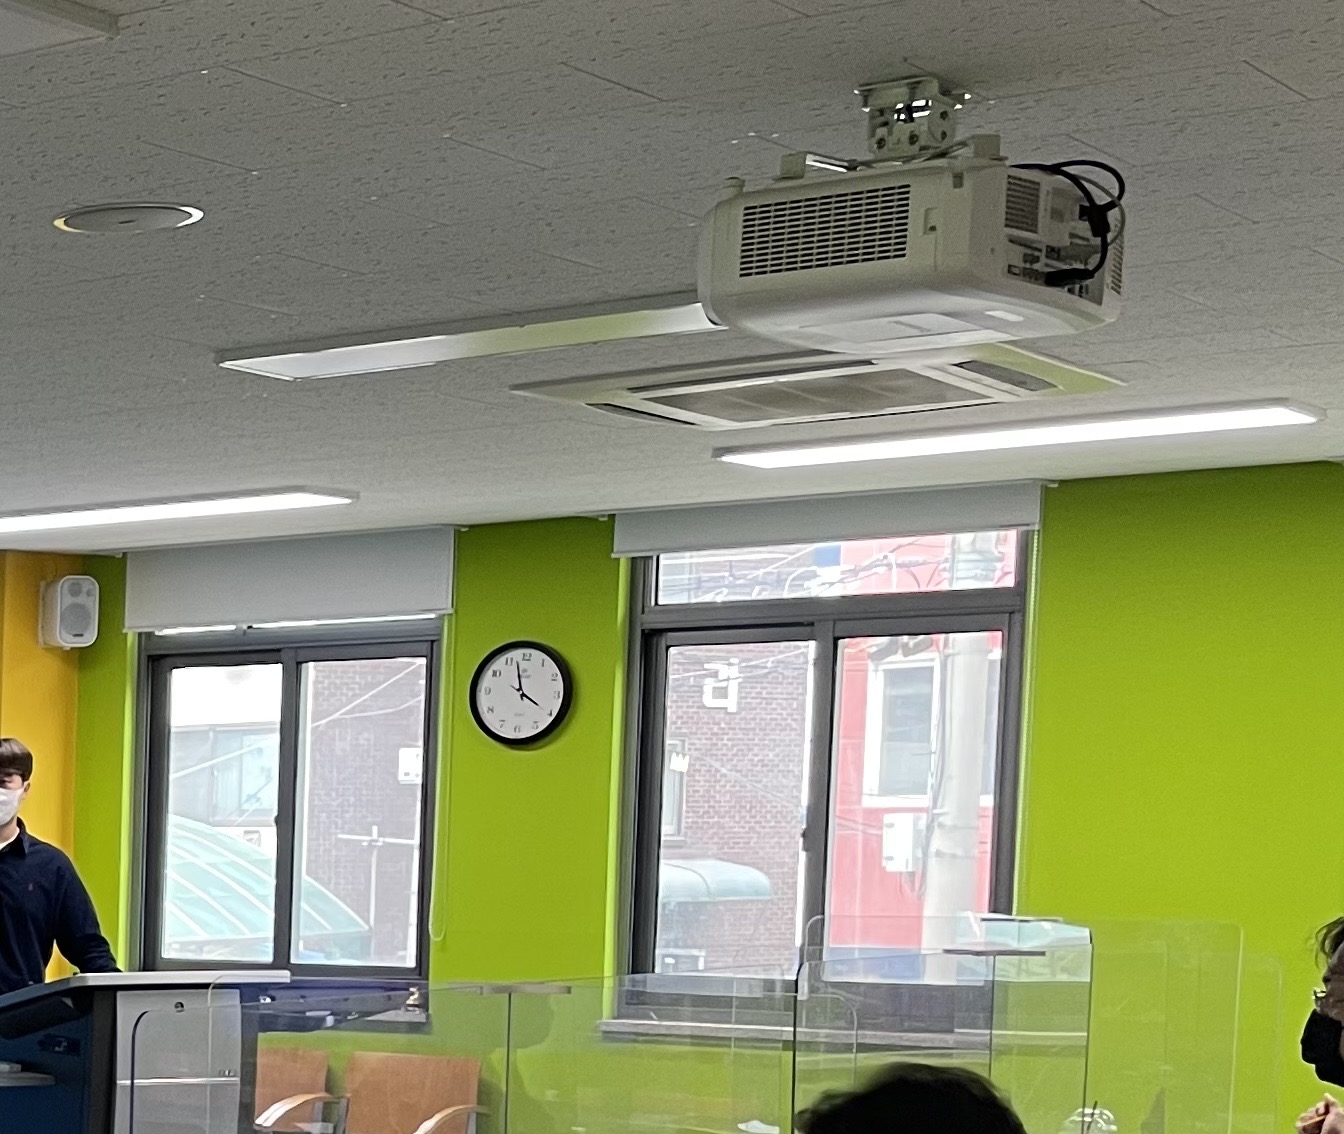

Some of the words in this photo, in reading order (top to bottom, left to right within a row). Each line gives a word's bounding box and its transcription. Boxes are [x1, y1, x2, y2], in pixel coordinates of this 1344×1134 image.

[505, 657, 514, 667] 11
[522, 652, 533, 662] 12
[541, 658, 546, 668] 1
[492, 669, 502, 678] 10
[551, 672, 559, 681] 2
[484, 686, 492, 696] 9
[553, 690, 561, 700] 3
[487, 706, 495, 714] 8
[546, 709, 553, 717] 4
[498, 719, 506, 729] 7
[532, 720, 539, 730] 5
[513, 725, 521, 734] 6
